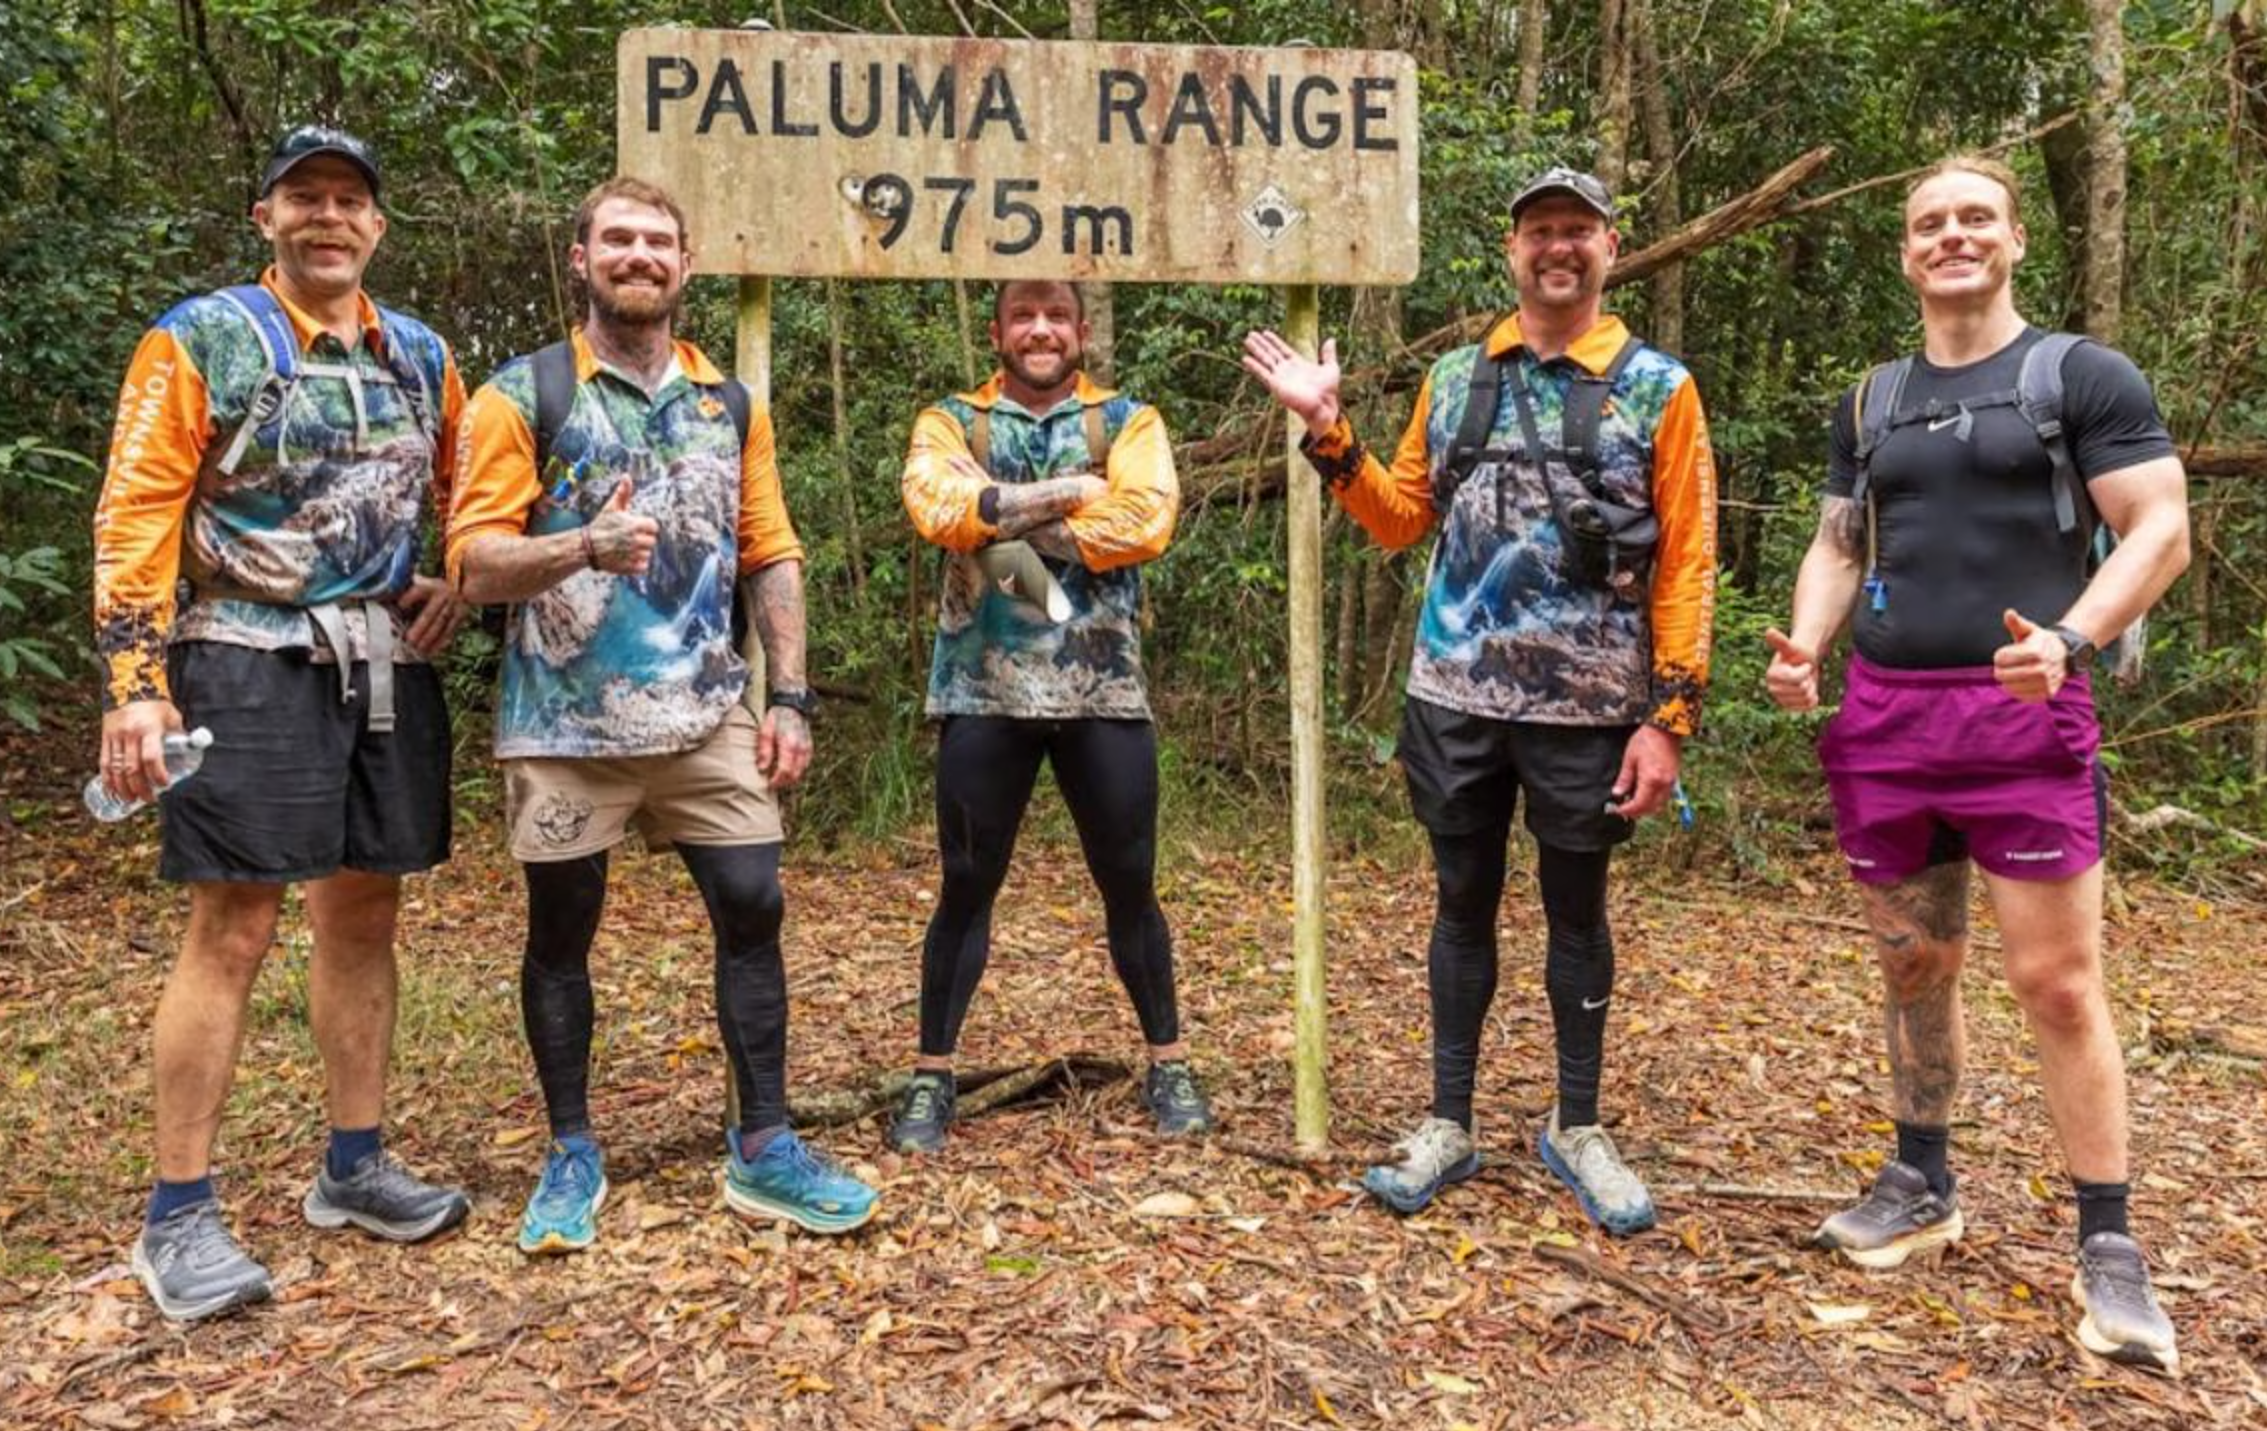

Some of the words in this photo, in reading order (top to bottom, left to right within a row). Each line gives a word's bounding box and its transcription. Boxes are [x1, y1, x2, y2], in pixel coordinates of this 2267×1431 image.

[646, 56, 1026, 141] PALUMA
[1098, 70, 1399, 151] RANGE
[861, 174, 1133, 257] 975m
[1696, 405, 1713, 556] QUEENSLAN
